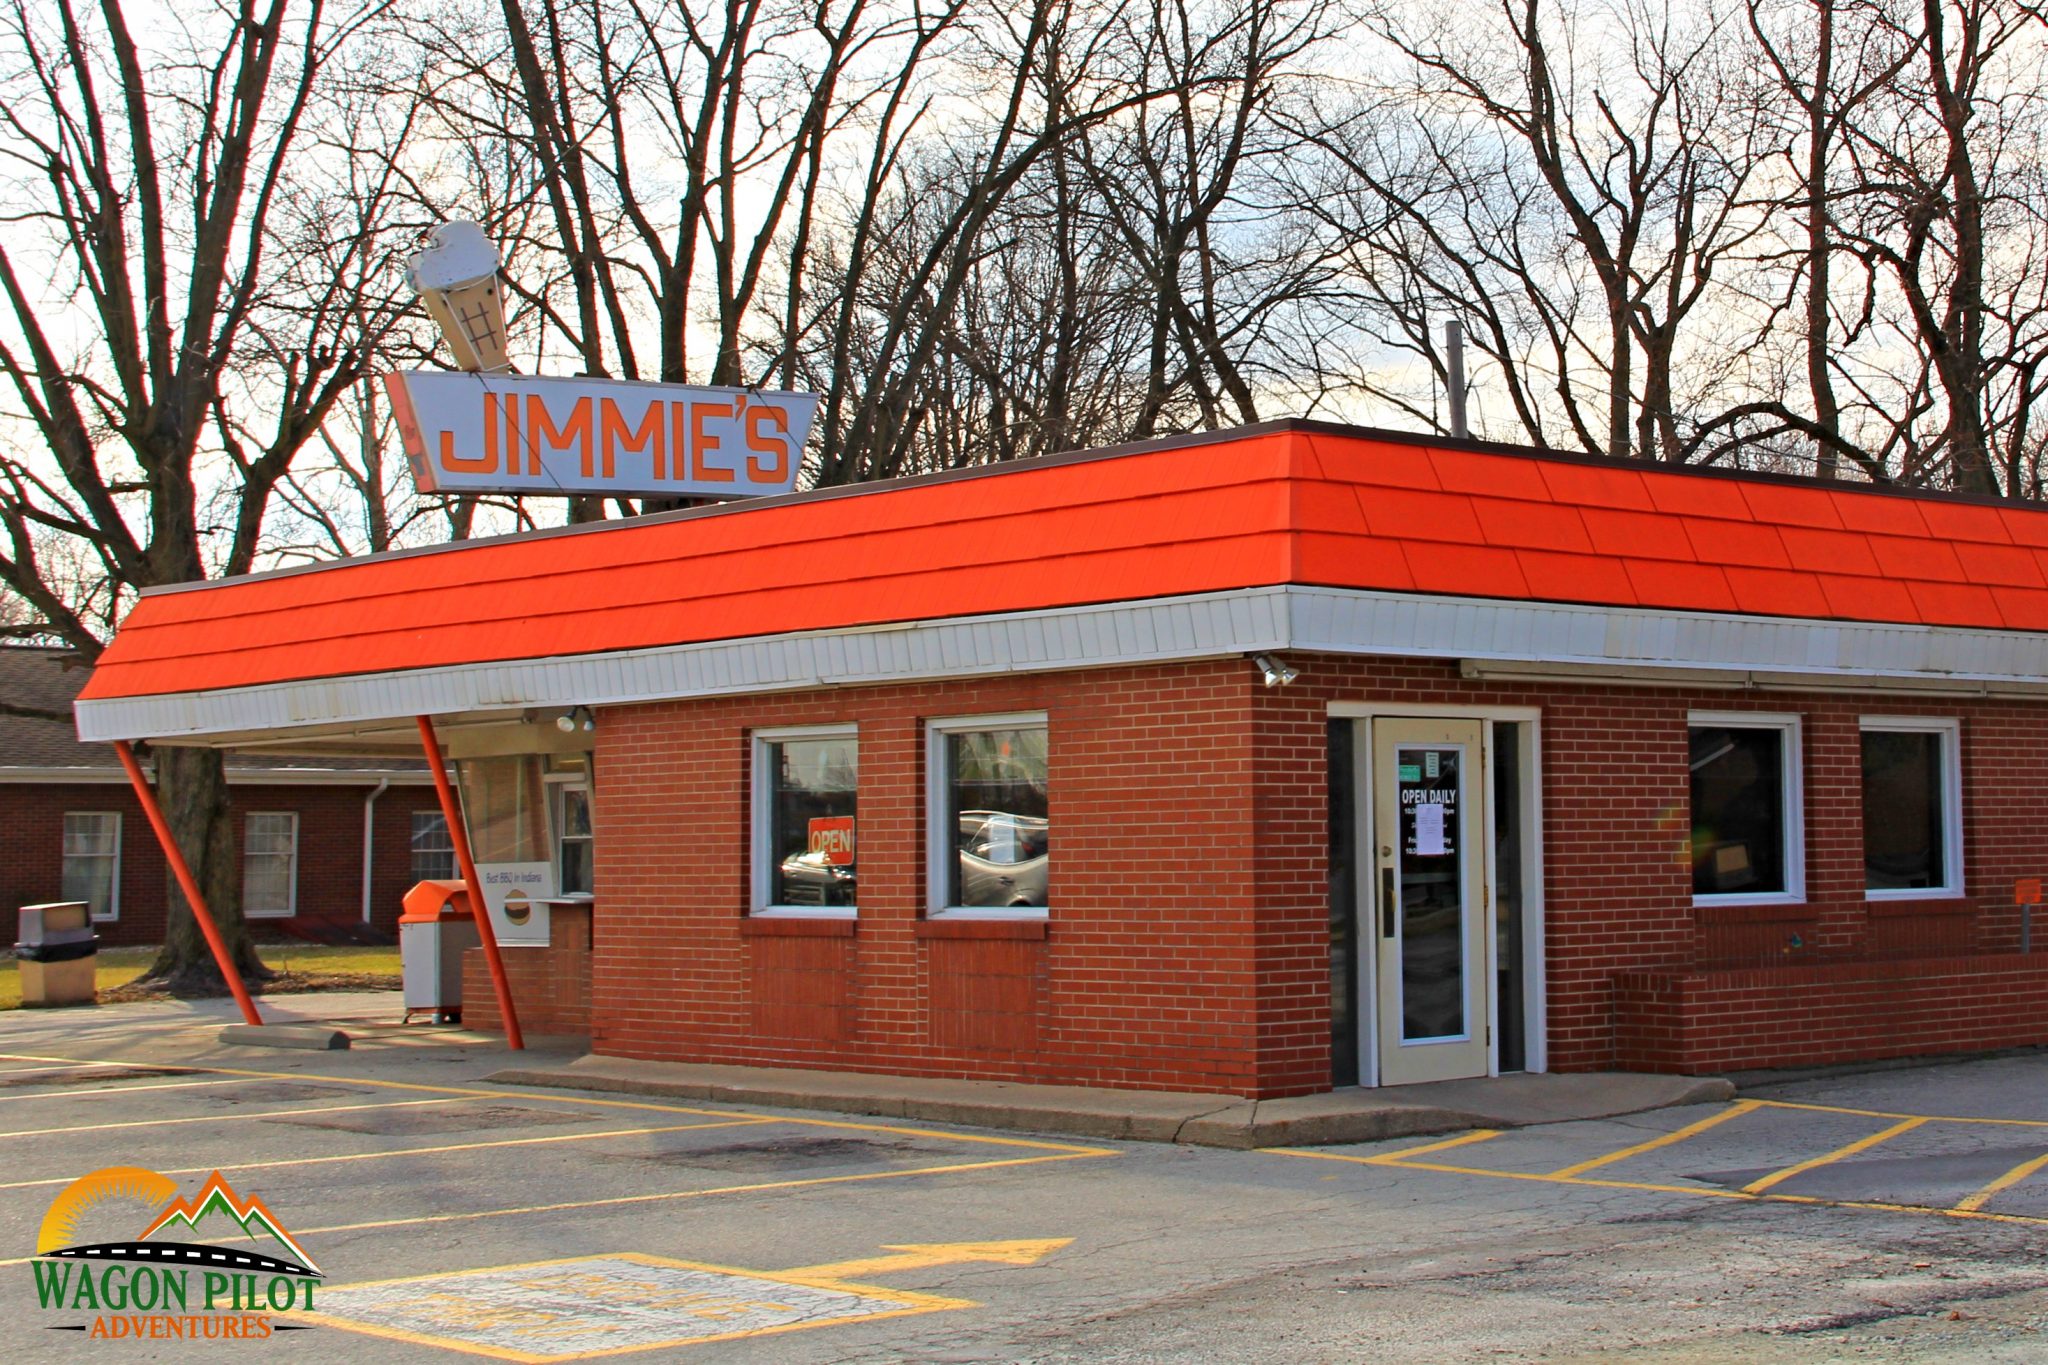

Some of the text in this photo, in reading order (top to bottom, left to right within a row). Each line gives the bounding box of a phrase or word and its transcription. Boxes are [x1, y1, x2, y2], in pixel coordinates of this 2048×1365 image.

[440, 392, 788, 484] JIMMIE'S
[1402, 789, 1456, 804] OPEN DAILY
[811, 829, 851, 853] OPEN
